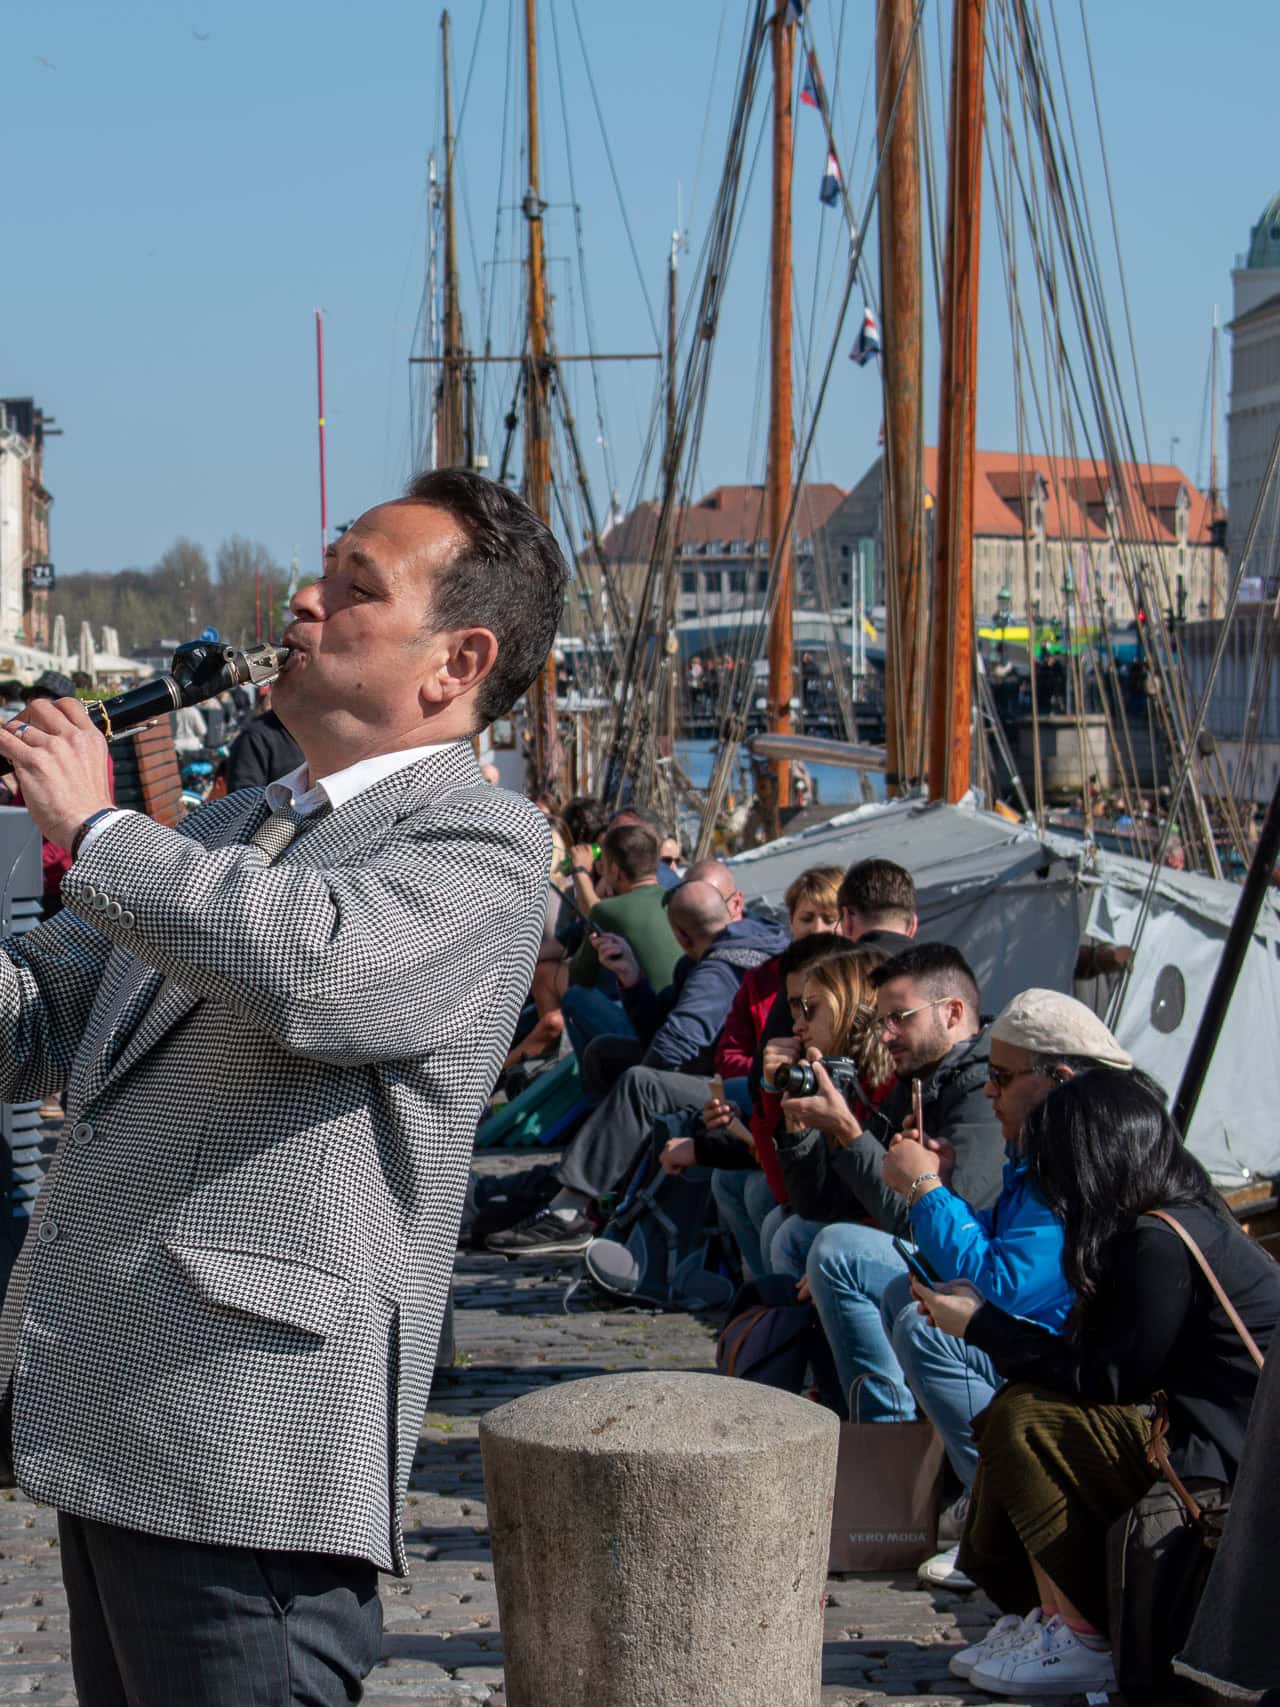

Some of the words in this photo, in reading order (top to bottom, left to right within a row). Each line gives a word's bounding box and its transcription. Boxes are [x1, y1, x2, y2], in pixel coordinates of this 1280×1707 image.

[848, 1533, 883, 1544] VERO
[886, 1532, 927, 1543] MODA
[1042, 1656, 1061, 1668] FILA
